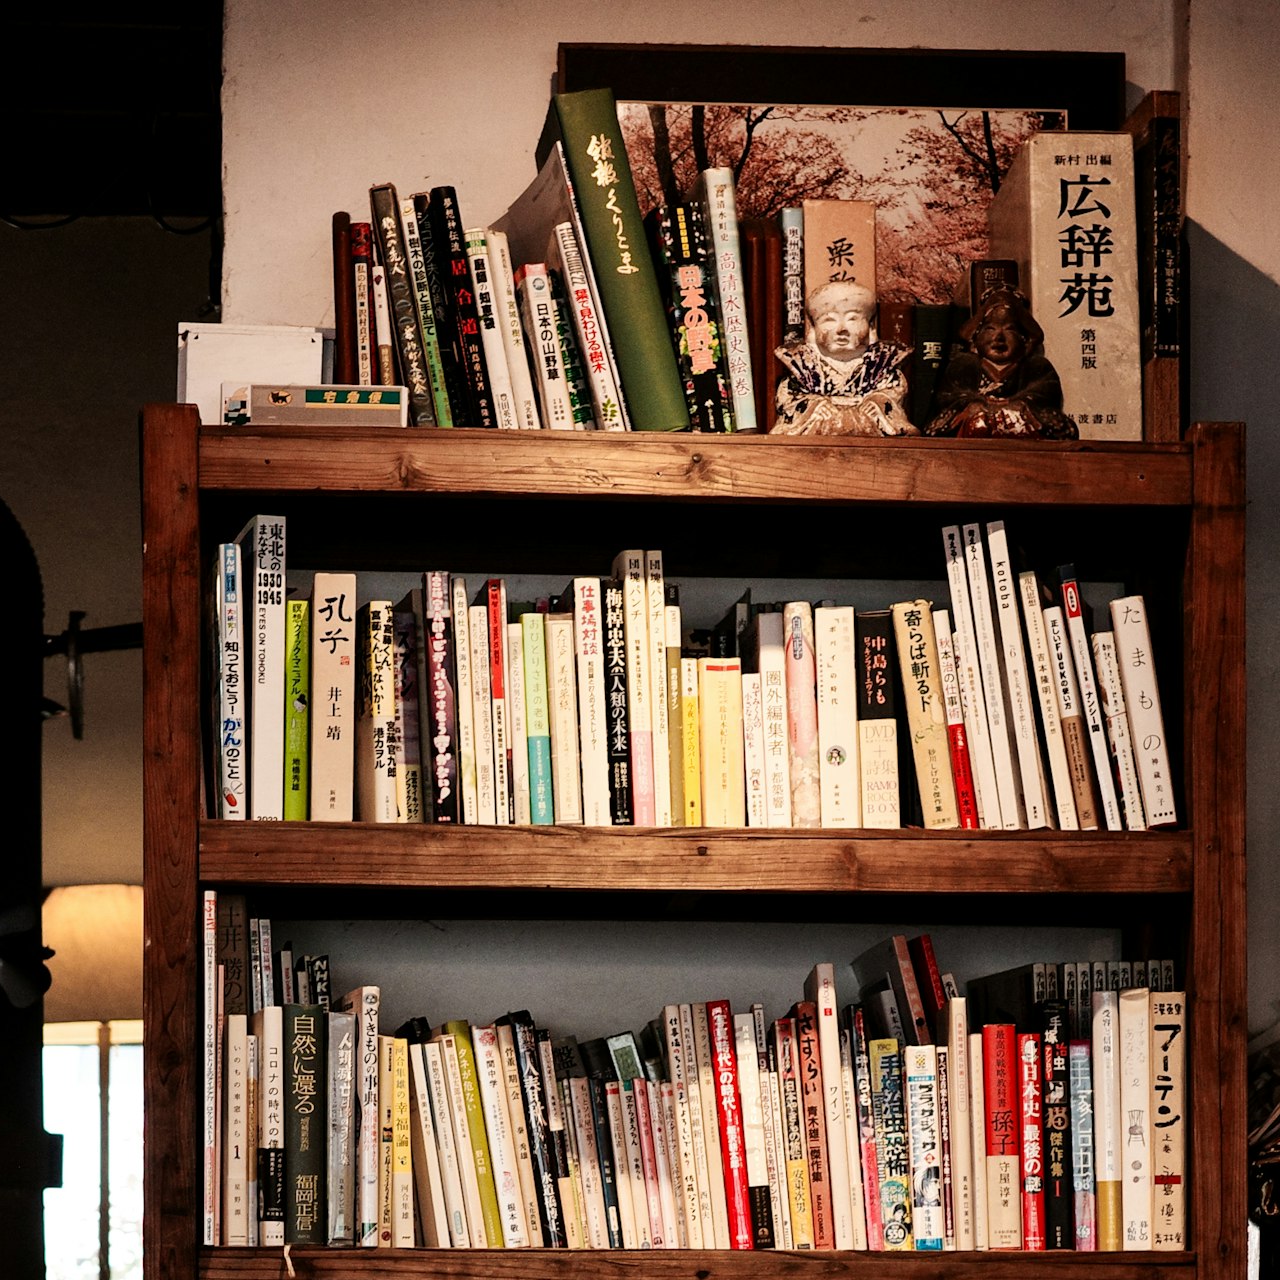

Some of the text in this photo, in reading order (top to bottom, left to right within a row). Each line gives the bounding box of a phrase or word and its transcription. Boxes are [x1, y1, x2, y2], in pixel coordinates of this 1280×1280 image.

[1054, 154, 1113, 167] 新村 出編
[1057, 173, 1115, 319] 広辞苑
[407, 237, 436, 337] 樹木の診断と手当て
[451, 259, 480, 336] 居合道
[676, 264, 717, 373] 日本の野草
[787, 277, 802, 326] 戦国物語
[507, 299, 523, 348] 宮城の樹木
[536, 302, 561, 382] 日本の山野草
[573, 288, 608, 375] 葉で見わける樹木
[718, 251, 751, 397] 高清水歴史絵巻
[1080, 328, 1098, 370] 第四版
[258, 523, 267, 571] まなざし
[268, 523, 285, 571] 東北への
[995, 561, 1011, 611] kotoba
[258, 607, 266, 685] EYES ON TOHOKU
[289, 602, 304, 696] 瞑想クイック・マニュアル
[317, 592, 354, 655] 孔子
[579, 585, 599, 656] 仕事場対談
[528, 618, 546, 731] おひとりさまの老後
[605, 588, 628, 758] 梅棹忠夫の「人類の未来」
[871, 634, 887, 706] 中島らも
[938, 637, 961, 720] 秋本治の仕事術
[1035, 652, 1052, 696] 吉本隆明
[1051, 619, 1073, 711] 正しいFUCKの使い方
[1122, 604, 1163, 752] たまもの
[326, 686, 343, 742] 井上靖
[765, 670, 783, 757] 圏外編集者
[1084, 690, 1102, 734] ナンシー関
[222, 717, 241, 780] がんのこと
[373, 727, 386, 770] 港カヲル
[384, 720, 398, 779] 宮藤官九郎
[866, 780, 897, 790] RAMO
[866, 803, 898, 814] BOX
[867, 791, 897, 802] ROCK
[291, 1014, 317, 1114] 自然に還る
[363, 1007, 378, 1107] やきものの事典
[484, 1049, 498, 1089] 夜間中学
[797, 1013, 819, 1096] さすらい
[995, 1029, 1007, 1108] 最高の戦略教科書
[1153, 1024, 1182, 1128] フーテン
[233, 1044, 241, 1138] いのちの車窓から
[395, 1045, 410, 1148] 河合隼雄の幸福論
[1021, 1064, 1040, 1119] 日本史
[991, 1109, 1015, 1155] 孫子
[1049, 1131, 1064, 1178] 傑作集
[1162, 1133, 1172, 1154] 上巻
[633, 1156, 642, 1181] 中島らも
[998, 1161, 1012, 1198] 守屋淳
[295, 1174, 313, 1231] 福岡正信
[400, 1184, 410, 1220] 河合隼雄
[885, 1228, 905, 1239] 550
